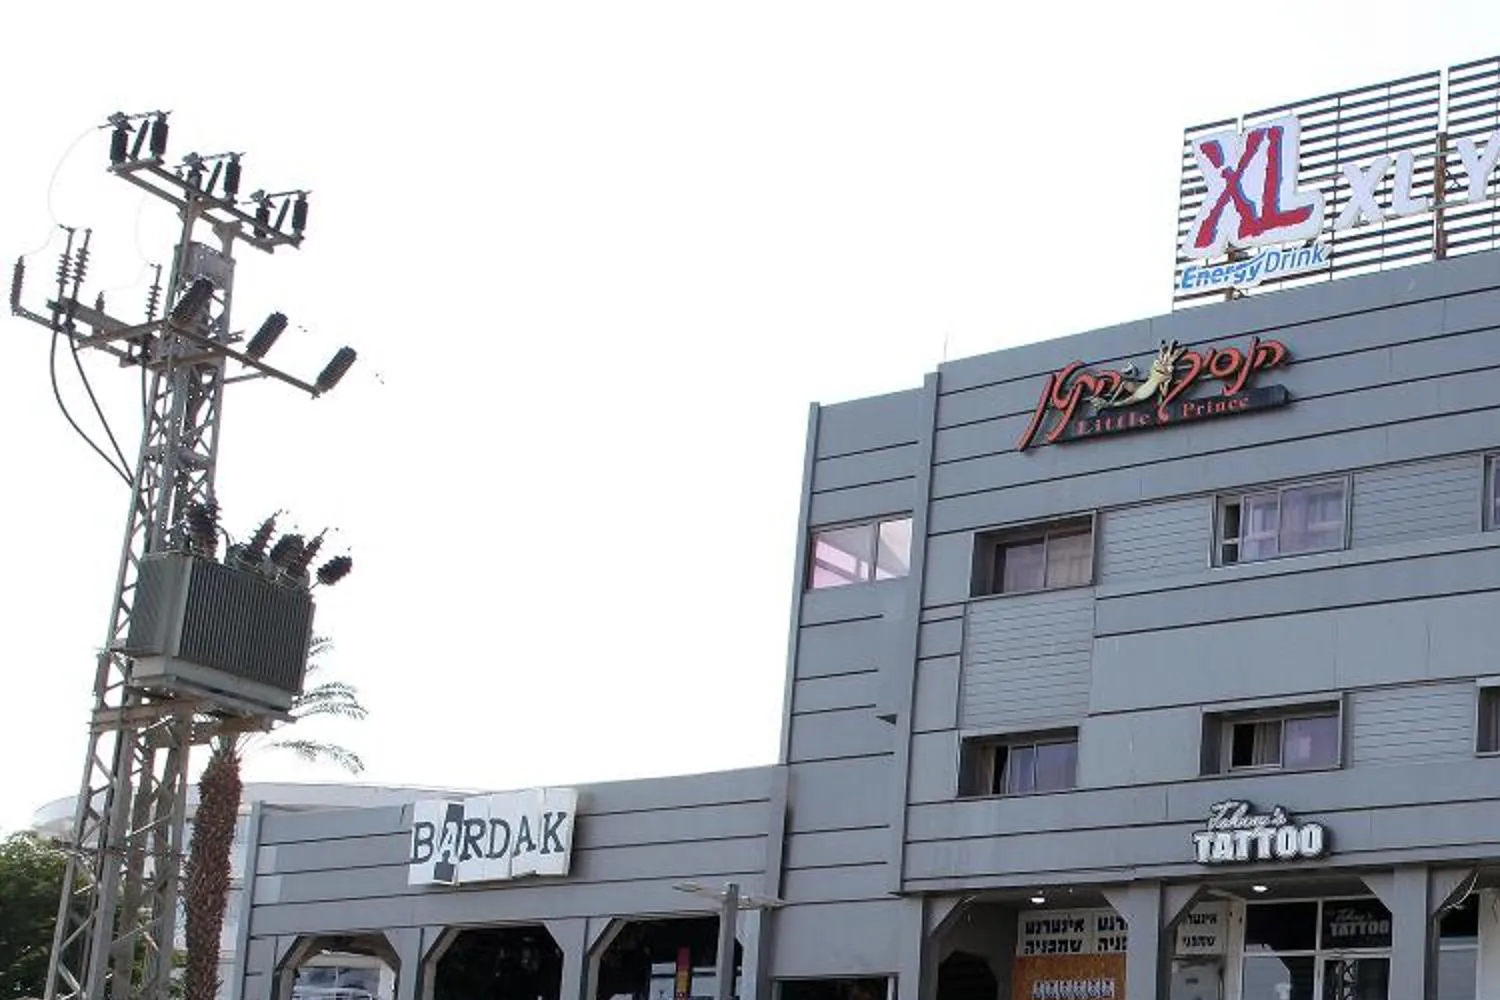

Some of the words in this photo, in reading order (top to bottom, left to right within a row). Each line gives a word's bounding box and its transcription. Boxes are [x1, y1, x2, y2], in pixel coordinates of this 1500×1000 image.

[1190, 122, 1321, 252] XL
[1334, 150, 1430, 231] XL
[1181, 254, 1265, 289] Energy
[1264, 247, 1326, 273] Drink
[1076, 411, 1151, 435] Little
[1182, 397, 1250, 418] Prince
[411, 806, 567, 876] BARDAK
[1193, 823, 1324, 863] TATTOO
